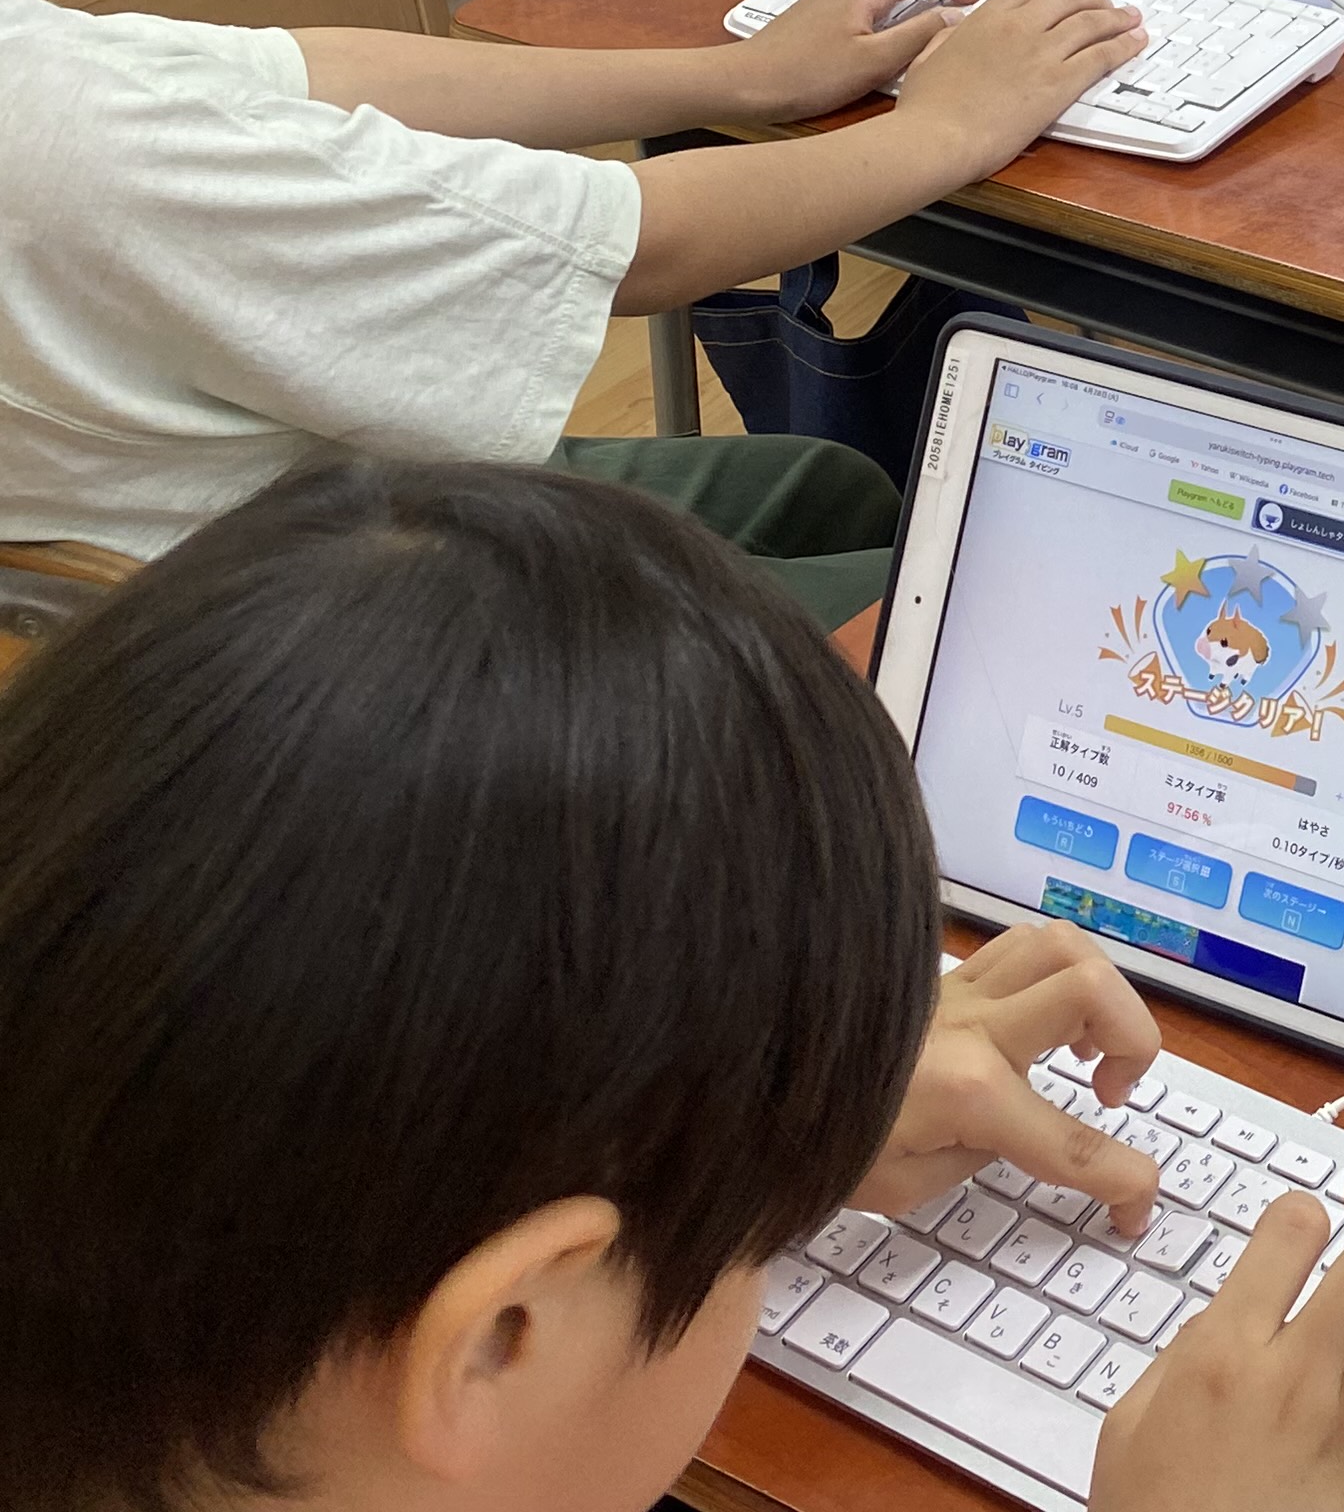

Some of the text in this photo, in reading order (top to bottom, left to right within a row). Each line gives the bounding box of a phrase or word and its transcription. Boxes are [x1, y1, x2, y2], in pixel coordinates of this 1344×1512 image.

[1289, 488, 1320, 502] Facebook
[1058, 699, 1084, 718] Lv.5
[1051, 763, 1066, 779] 10
[1075, 769, 1099, 789] 409
[1200, 812, 1212, 827] %
[1297, 818, 1331, 838] はやさ
[1286, 914, 1297, 928] N
[1176, 1159, 1191, 1173] 6
[1231, 1183, 1248, 1197] 7
[957, 1210, 975, 1225] D
[827, 1224, 847, 1242] Z
[1011, 1234, 1028, 1248] F
[1158, 1227, 1174, 1242] Y
[880, 1250, 898, 1268] X
[1213, 1252, 1232, 1268] U
[1067, 1262, 1084, 1279] G
[934, 1278, 952, 1294] C
[1120, 1289, 1140, 1306] H
[762, 1306, 780, 1321] md
[989, 1303, 1008, 1320] V
[819, 1332, 850, 1356] 英数
[1043, 1332, 1062, 1350] B
[1100, 1360, 1121, 1380] N
